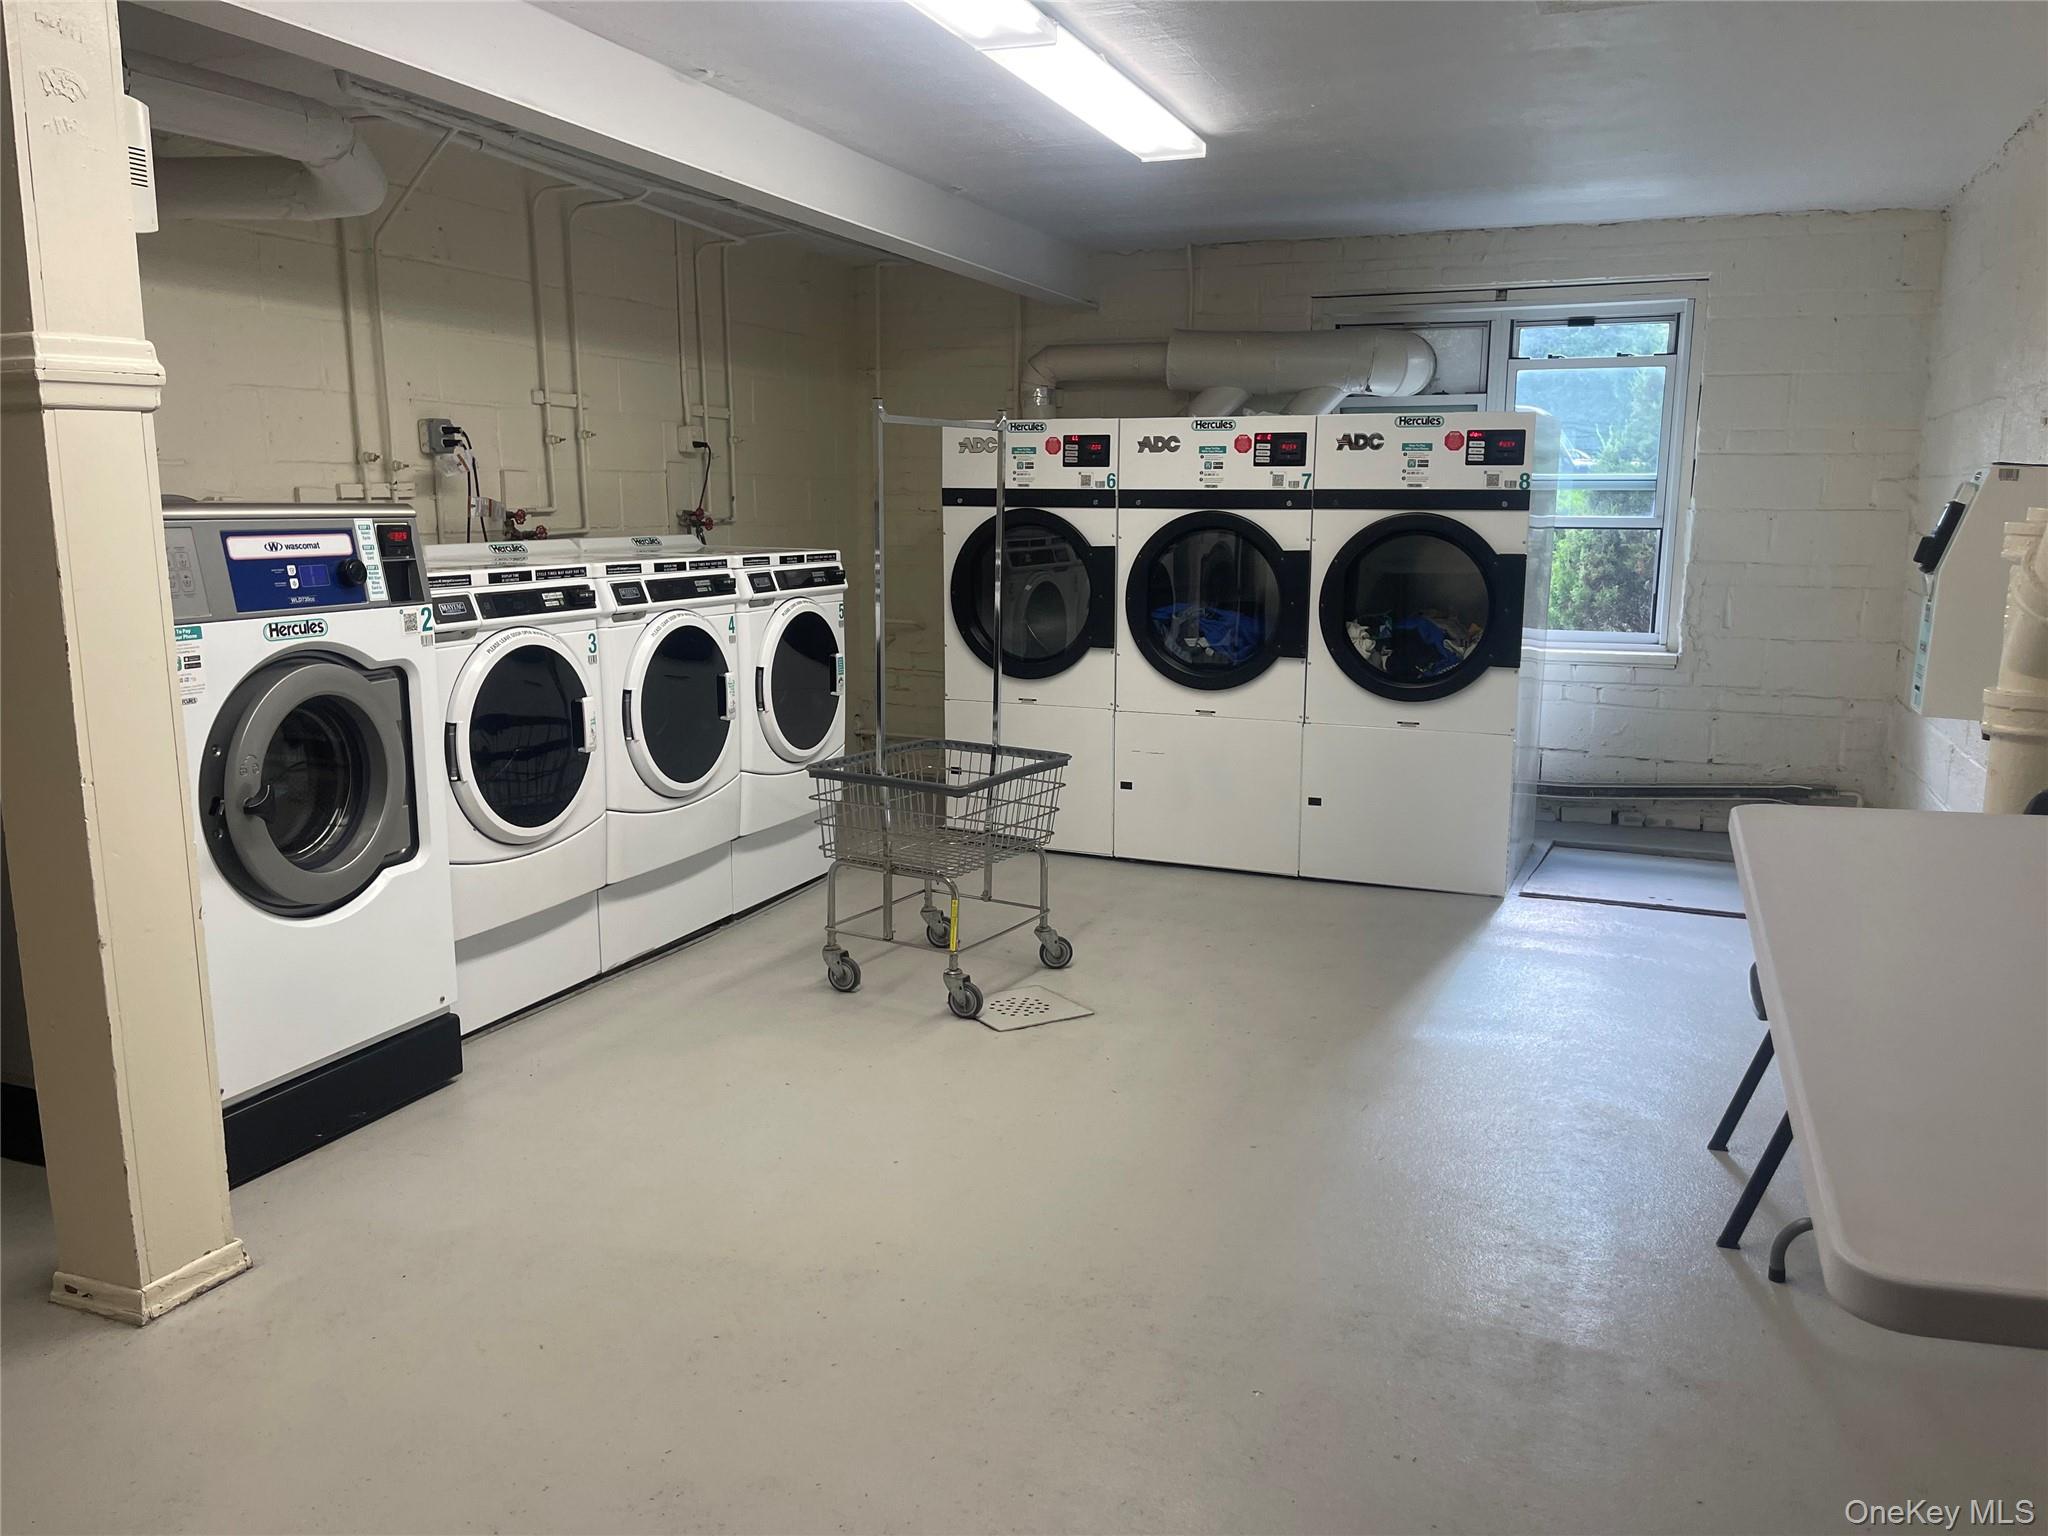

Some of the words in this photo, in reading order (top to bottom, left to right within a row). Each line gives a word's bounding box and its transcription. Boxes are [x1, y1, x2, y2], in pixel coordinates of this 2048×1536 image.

[1010, 423, 1045, 432] Hercules
[1195, 420, 1233, 429] Hercules
[1399, 416, 1441, 425] Hercules
[958, 437, 998, 453] ADC
[1137, 435, 1181, 453] ADC
[1336, 432, 1384, 450] ADC
[1107, 473, 1116, 488] 6
[1301, 473, 1312, 489] 7
[1519, 473, 1530, 489] 8
[284, 542, 321, 550] wascomat
[490, 544, 525, 553] Hercules
[839, 603, 844, 619] 5
[420, 607, 433, 632] 2
[728, 616, 735, 633] 4
[268, 620, 324, 639] Hercules
[588, 633, 597, 653] 3
